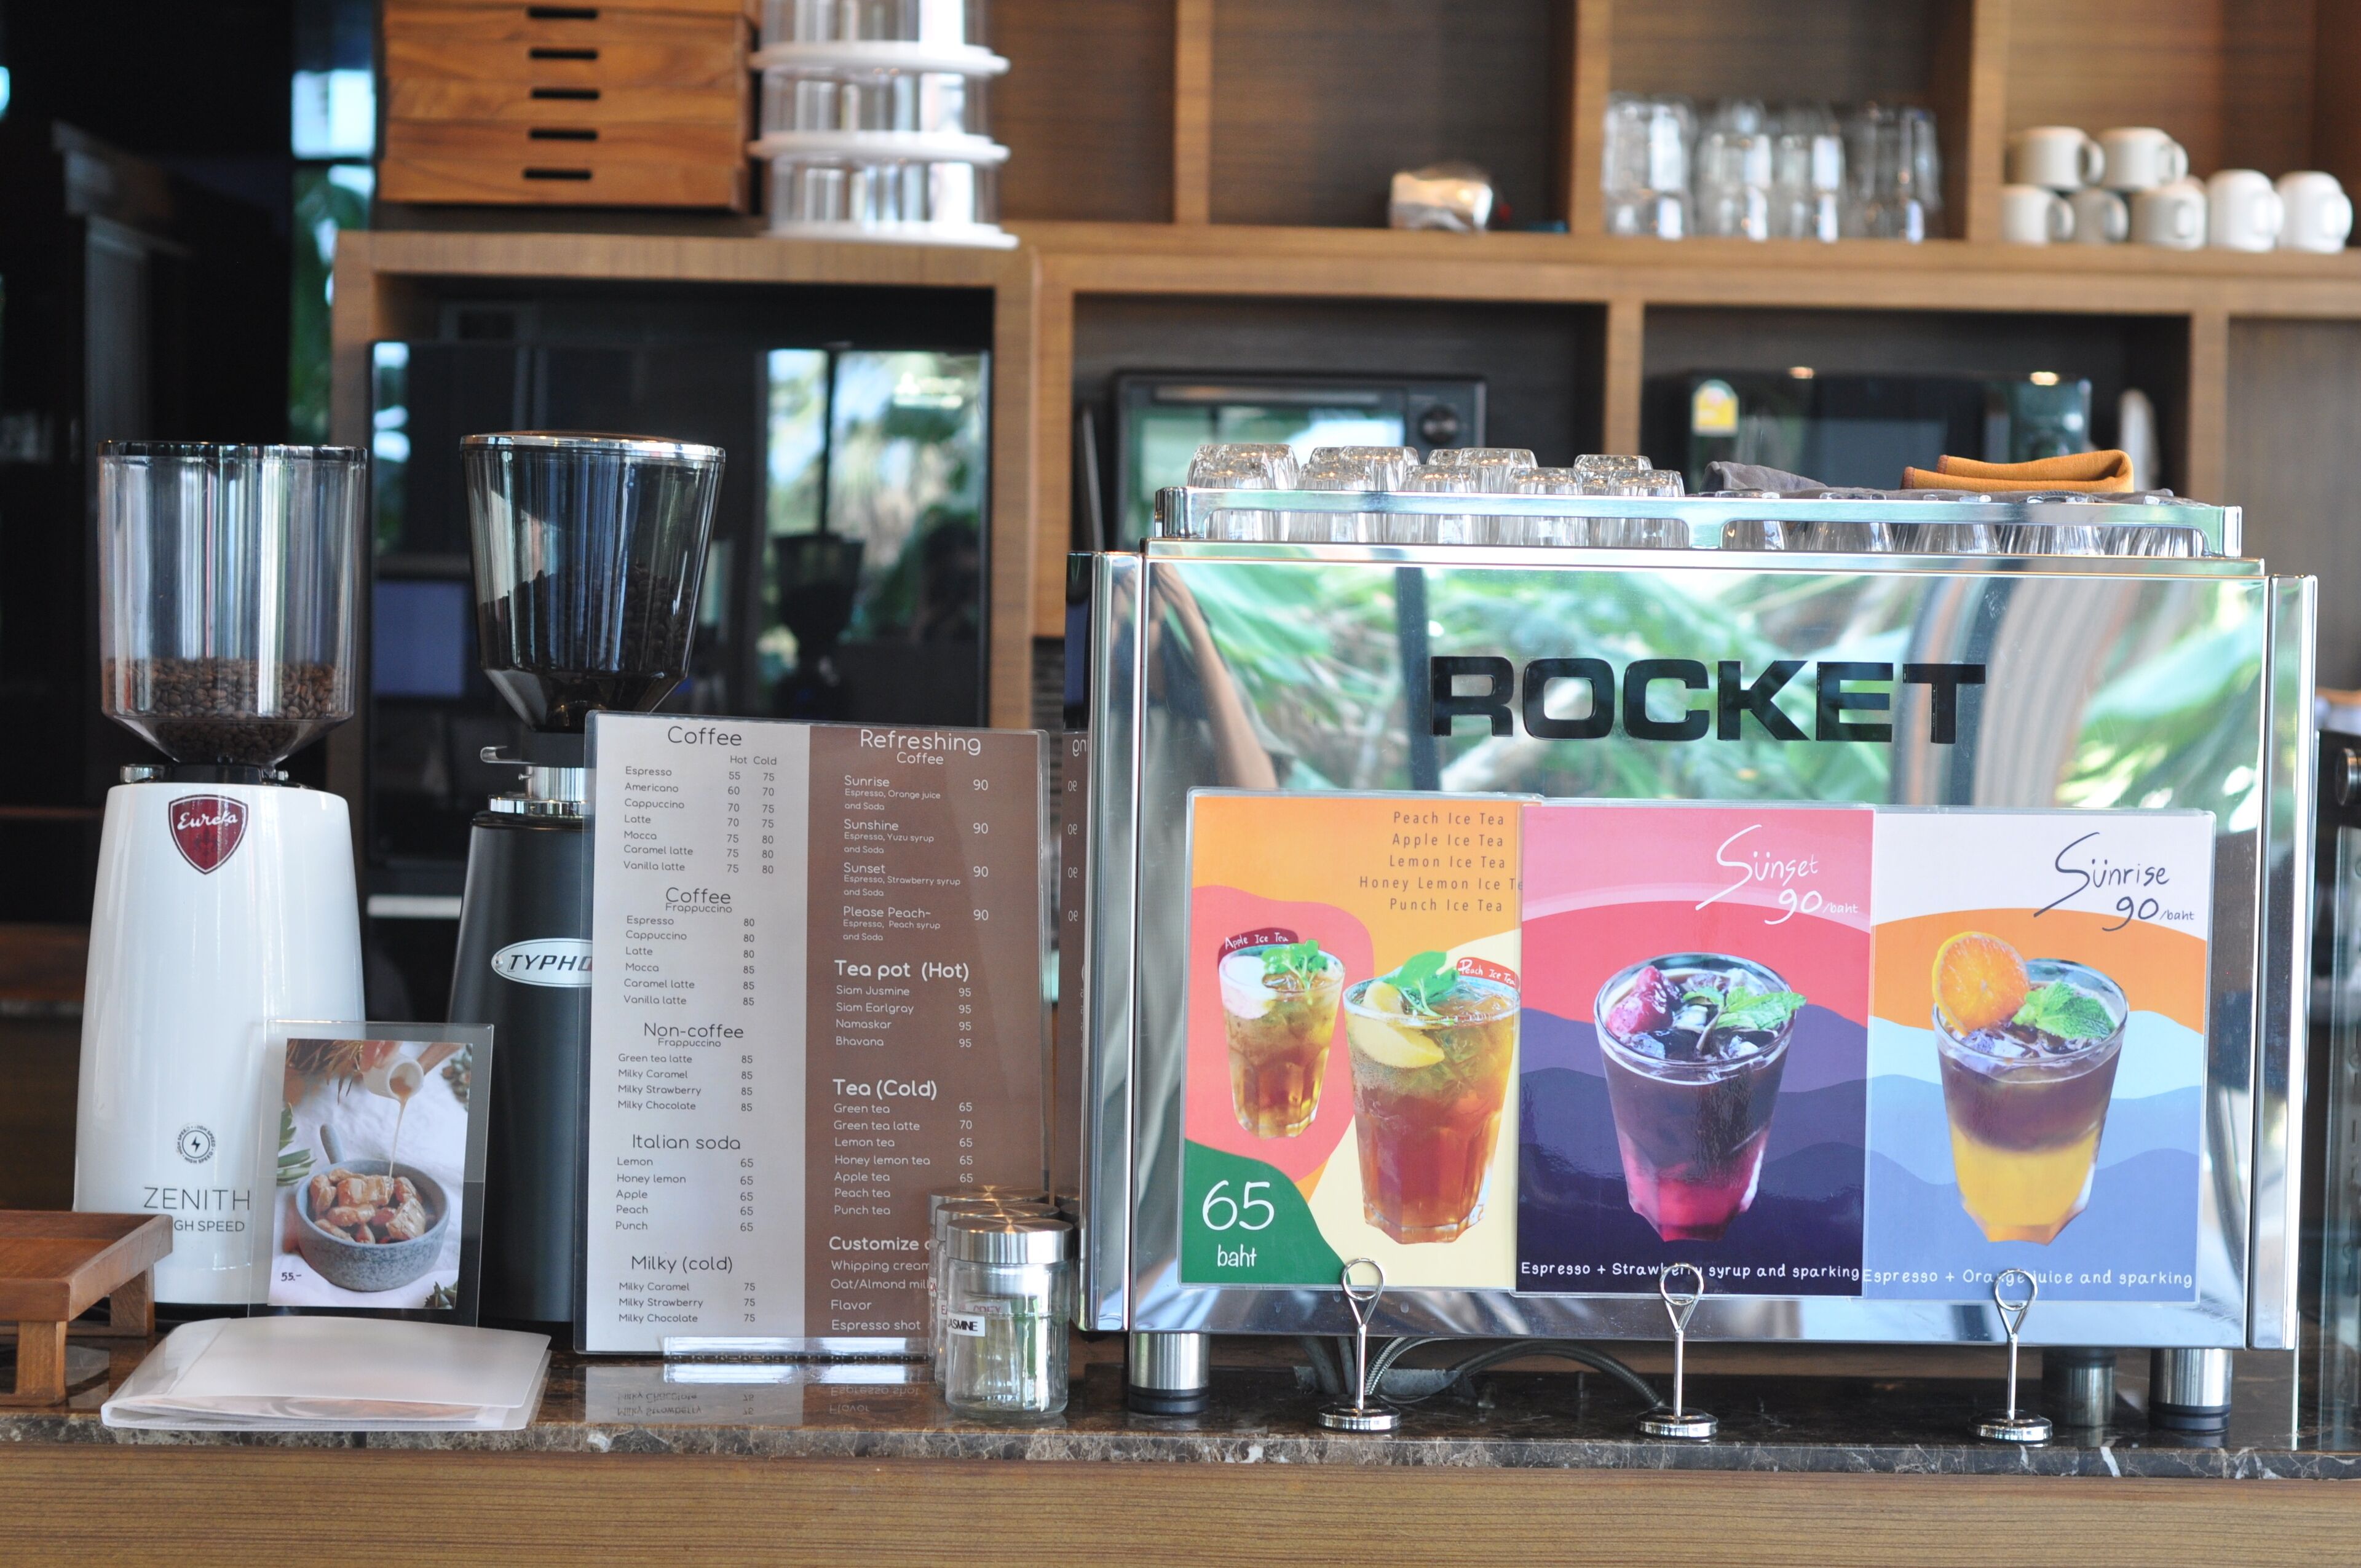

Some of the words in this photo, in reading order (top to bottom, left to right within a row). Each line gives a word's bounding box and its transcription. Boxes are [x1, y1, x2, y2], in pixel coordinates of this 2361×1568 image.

[1430, 656, 1986, 744] ROCKET
[668, 726, 742, 746] Coffee
[860, 729, 982, 756] Refreshing
[754, 756, 777, 765] Cold
[896, 752, 944, 765] Coffee
[626, 766, 671, 777] Espresso
[845, 775, 890, 786] Sunrise
[973, 779, 988, 790] 90
[625, 782, 678, 792] Americano
[728, 786, 740, 795] 60
[763, 787, 774, 796] 70
[845, 788, 885, 798] Espresso,
[888, 790, 920, 799] Orange
[625, 798, 684, 809] Cappuccino
[728, 803, 739, 812] 70
[762, 804, 774, 814] 75
[177, 810, 238, 830] Eureka
[625, 815, 651, 823] Latte
[1394, 812, 1438, 824] Peach
[1449, 812, 1470, 825] Ice
[1480, 813, 1503, 825] Tea
[844, 818, 898, 831] Sunshine
[973, 823, 988, 834] 90
[624, 831, 657, 840] Mocca
[844, 832, 885, 841] Espresso,
[1393, 833, 1438, 849] Apple
[1448, 834, 1469, 846] Ice
[1479, 834, 1502, 846] Tea
[624, 845, 666, 854] Caramel
[623, 861, 658, 870] Vanilla
[662, 862, 685, 871] latte
[1390, 855, 1439, 867] Lemon
[1450, 856, 1471, 868] Ice
[1481, 856, 1504, 868] Tea
[844, 862, 885, 873] Sunset
[973, 866, 988, 877] 90
[844, 874, 885, 884] Espresso,
[887, 876, 934, 885] Strawberry
[1360, 876, 1408, 892] Honey
[1418, 877, 1468, 889] Lemon
[1479, 878, 1500, 890] Ice
[665, 887, 731, 905] Coffee
[665, 903, 732, 914] Frappuccino
[1391, 898, 1436, 910] Punch
[1447, 899, 1468, 911] Ice
[1478, 900, 1501, 911] Tea
[1765, 889, 1822, 925] 90
[844, 906, 884, 917] Please
[974, 909, 989, 921] 90
[2102, 897, 2159, 932] 90
[627, 916, 674, 925] Espresso
[844, 919, 884, 928] Espresso,
[626, 930, 687, 941] Cappuccino
[1225, 935, 1248, 950] Apple
[1255, 935, 1268, 943] Ice
[1275, 932, 1288, 943] Tea
[834, 960, 871, 976] Tea
[878, 963, 911, 980] pot
[922, 962, 968, 982] (Hot)
[1460, 959, 1484, 976] Peach
[1489, 968, 1502, 979] Ice
[1504, 973, 1515, 985] Tea
[837, 985, 862, 994] Siam
[866, 986, 909, 996] Jusmine
[836, 1002, 862, 1012] Siam
[866, 1003, 914, 1015] Earlgray
[836, 1019, 892, 1029] Namaskar
[644, 1022, 744, 1039] Non-coffee
[658, 1038, 721, 1048] Frappuccino
[836, 1036, 884, 1046] Bhavana
[619, 1053, 647, 1062] Green
[619, 1069, 643, 1079] Milky
[647, 1070, 687, 1079] Caramel
[619, 1085, 643, 1095] Milky
[647, 1085, 701, 1096] Strawberry
[833, 1079, 871, 1095] Tea
[877, 1080, 936, 1100] (Cold)
[834, 1103, 868, 1113] Green
[633, 1134, 689, 1149] Italian
[696, 1136, 740, 1149] soda
[836, 1138, 873, 1146] Lemon
[877, 1138, 895, 1147] tea
[617, 1157, 653, 1166] Lemon
[836, 1155, 870, 1166] Honey
[874, 1155, 908, 1165] lemon
[617, 1174, 650, 1185] Honey
[654, 1174, 686, 1183] lemon
[616, 1190, 647, 1200] Apple
[835, 1188, 869, 1197] Peach
[872, 1189, 890, 1197] tea
[144, 1187, 250, 1210] ZENITH
[617, 1205, 648, 1214] Peach
[834, 1205, 868, 1214] Punch
[1203, 1180, 1275, 1230] 65
[198, 1221, 245, 1232] SPEED
[616, 1221, 647, 1230] Punch
[829, 1235, 919, 1251] Customize
[1217, 1244, 1256, 1267] baht
[632, 1256, 676, 1273] Milky
[683, 1256, 732, 1273] (cold)
[831, 1261, 889, 1272] Whipping
[1521, 1262, 1590, 1275] Espresso
[1708, 1266, 1750, 1279] syrup
[1757, 1264, 1785, 1277] and
[1792, 1264, 1859, 1281] sparking
[831, 1279, 906, 1290] Oat/Almond
[1863, 1269, 1938, 1284] Espresso
[1963, 1269, 2025, 1286] Orage
[2081, 1270, 2111, 1284] and
[2119, 1270, 2193, 1289] sparking
[831, 1300, 872, 1310] Flavor
[832, 1320, 890, 1332] Espresso
[894, 1320, 920, 1330] shot
